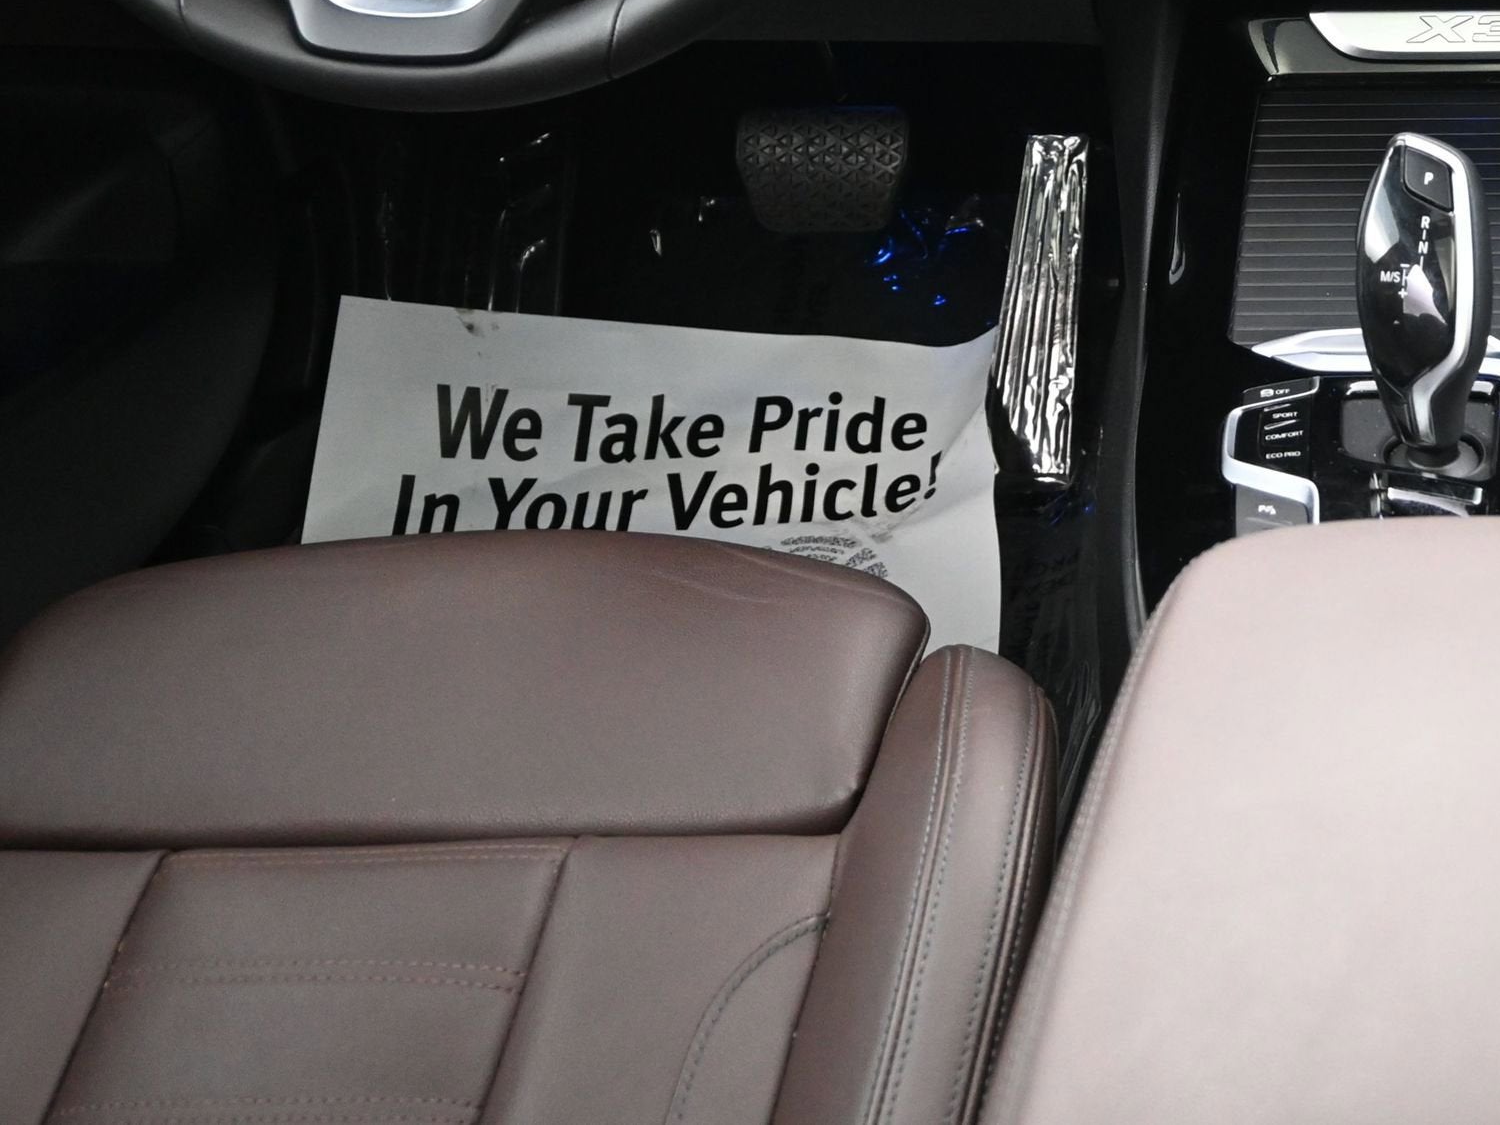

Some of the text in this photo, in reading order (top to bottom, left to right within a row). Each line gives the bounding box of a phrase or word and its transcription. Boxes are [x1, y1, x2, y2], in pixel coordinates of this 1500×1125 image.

[1423, 171, 1435, 185] P
[1420, 215, 1431, 230] R
[1418, 240, 1429, 255] N
[1380, 270, 1401, 283] M/S
[1272, 411, 1299, 419] SPORT
[436, 383, 928, 465] We Take Pride
[1265, 430, 1304, 441] COMFORT
[1265, 450, 1302, 460] ECO PRO
[392, 452, 943, 536] In Your Vehicle!
